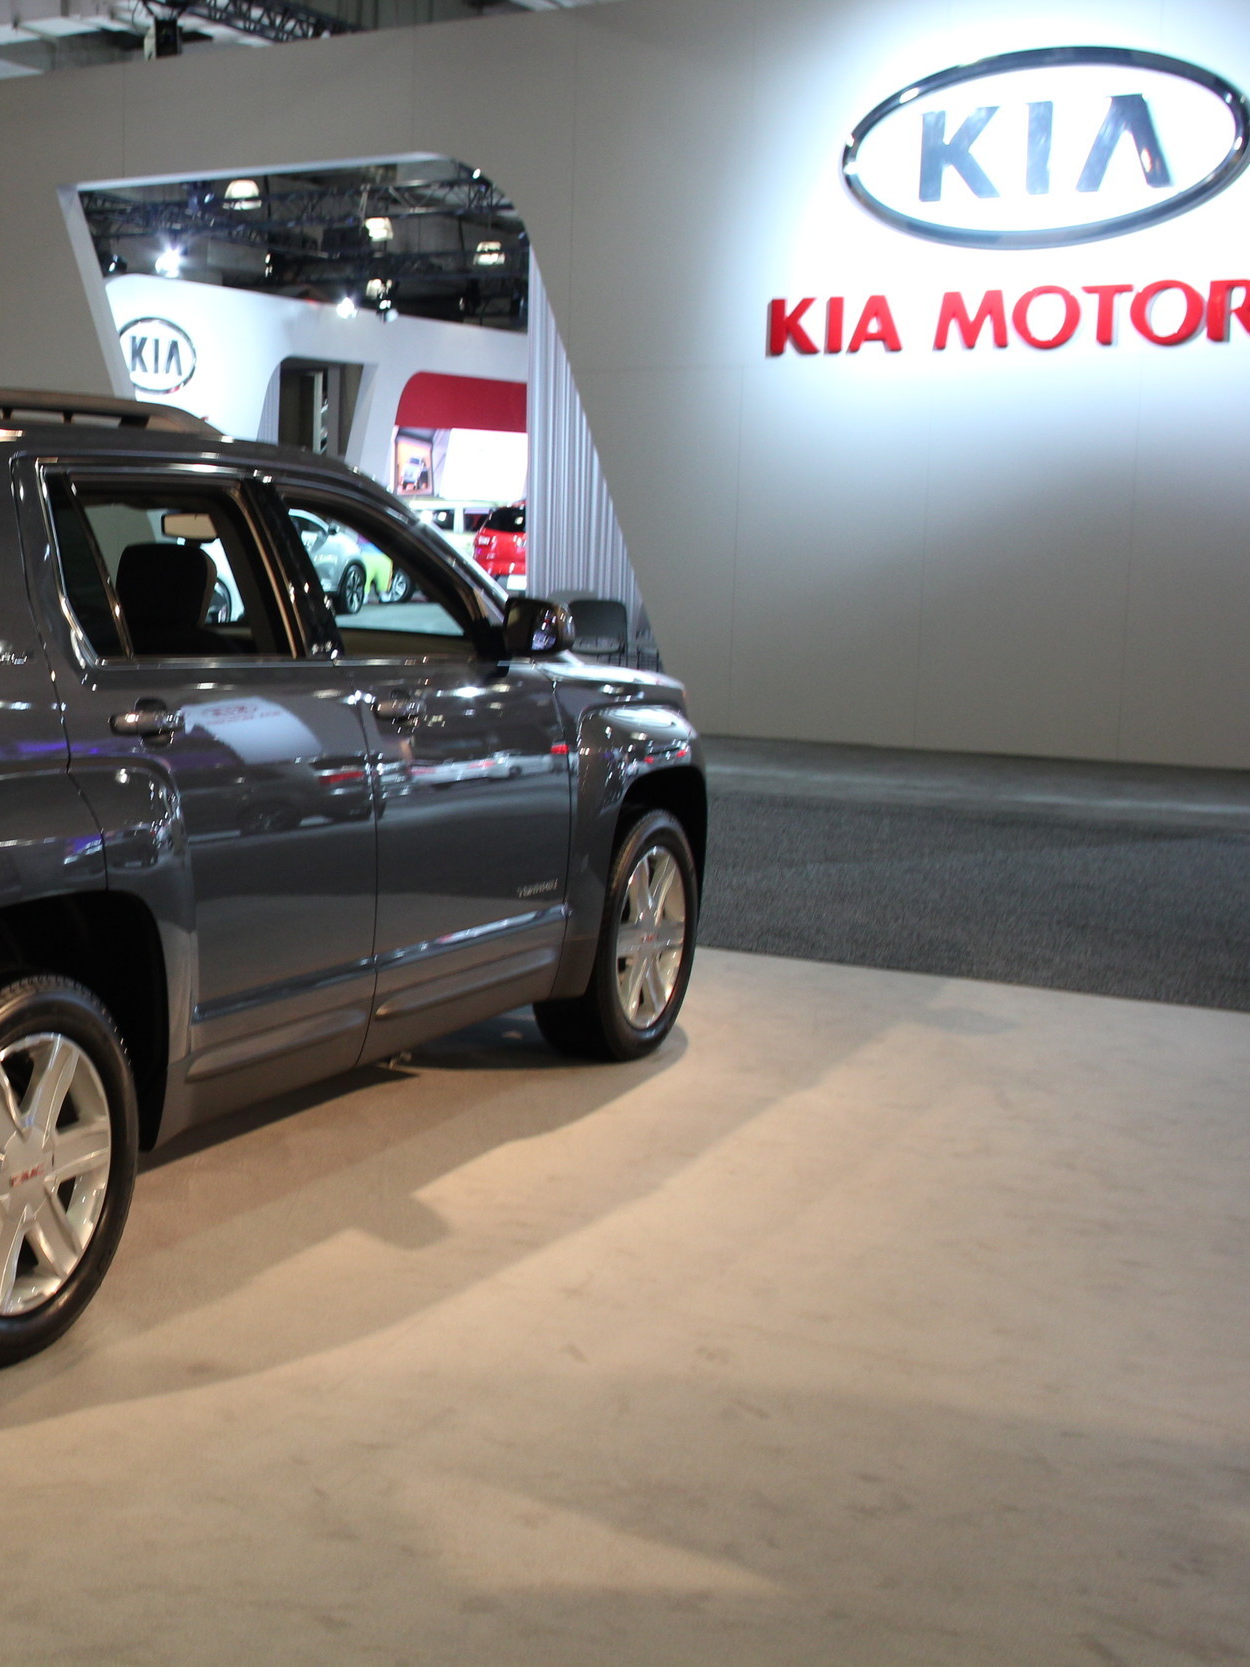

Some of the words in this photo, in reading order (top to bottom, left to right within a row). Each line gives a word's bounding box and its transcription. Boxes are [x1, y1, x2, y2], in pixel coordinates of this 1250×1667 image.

[918, 93, 1173, 203] KIA
[130, 335, 182, 376] KIA
[766, 294, 902, 358] KIA
[933, 279, 1250, 351] MOTOR
